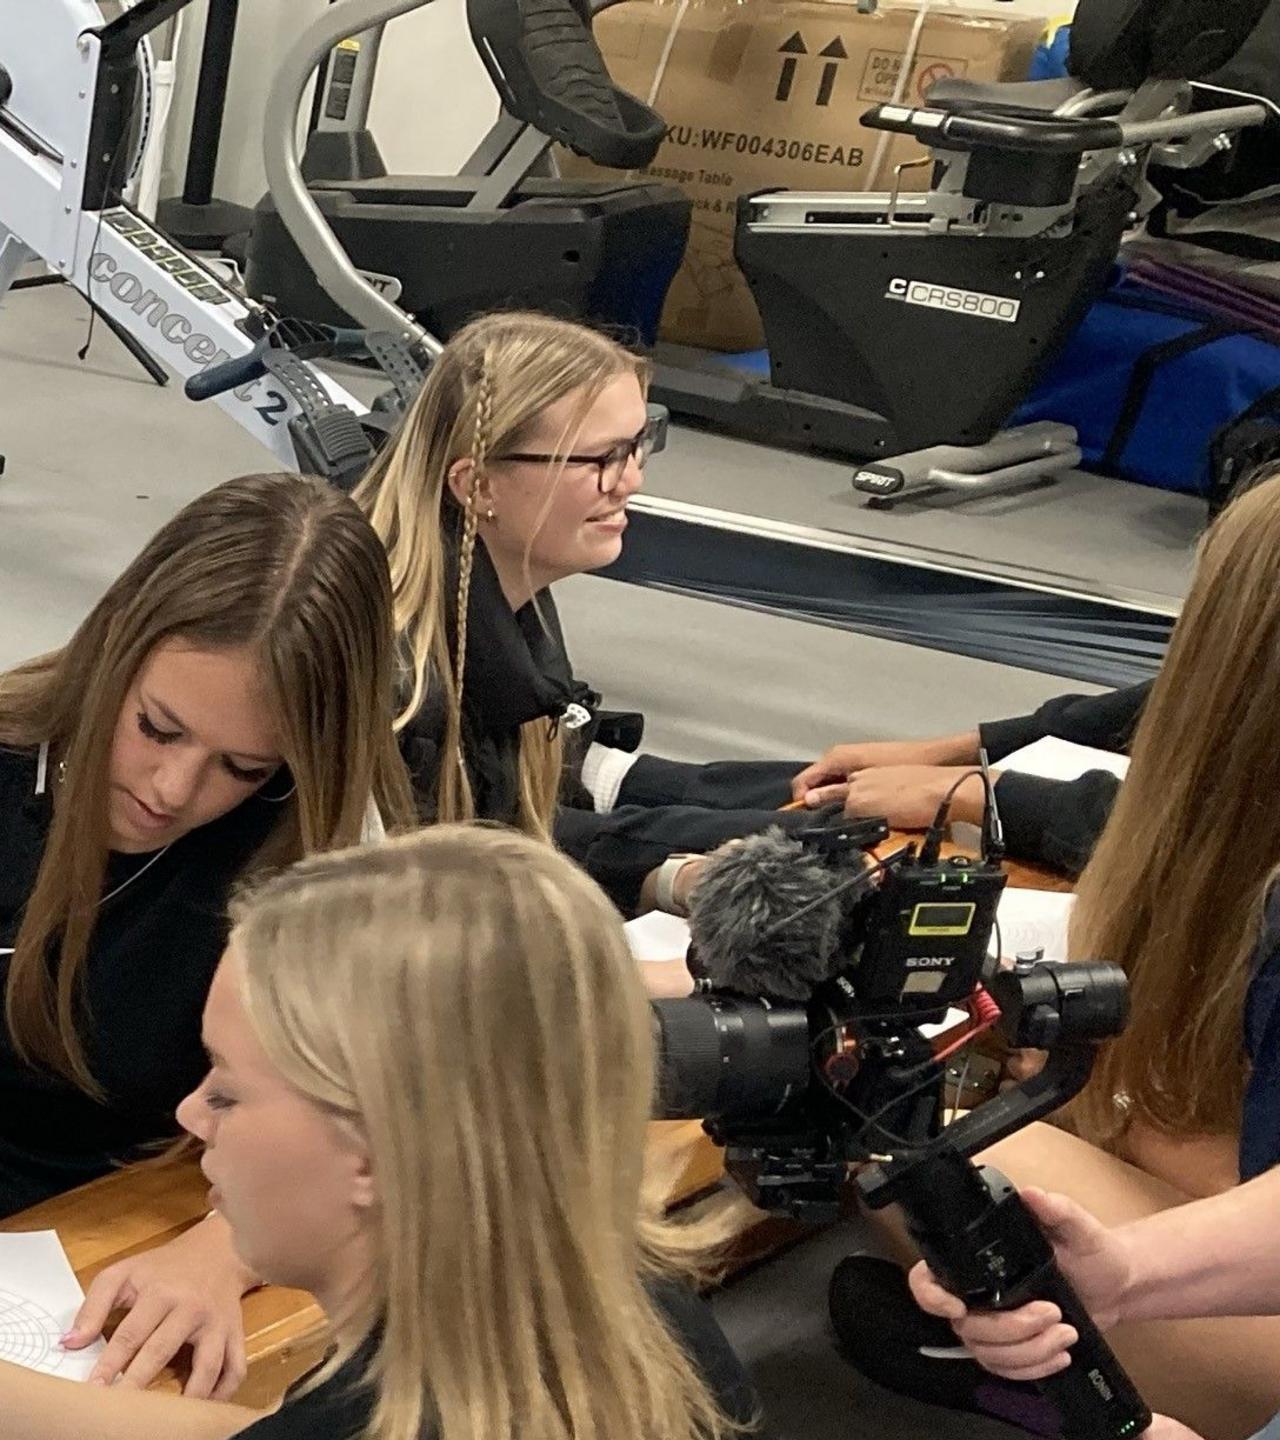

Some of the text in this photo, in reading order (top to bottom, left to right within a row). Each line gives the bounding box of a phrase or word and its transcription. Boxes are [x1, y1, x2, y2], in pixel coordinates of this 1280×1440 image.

[662, 124, 864, 168] KU:WF004306EAB
[911, 285, 1016, 318] CRS800
[254, 390, 288, 426] 2
[905, 956, 956, 967] SONY
